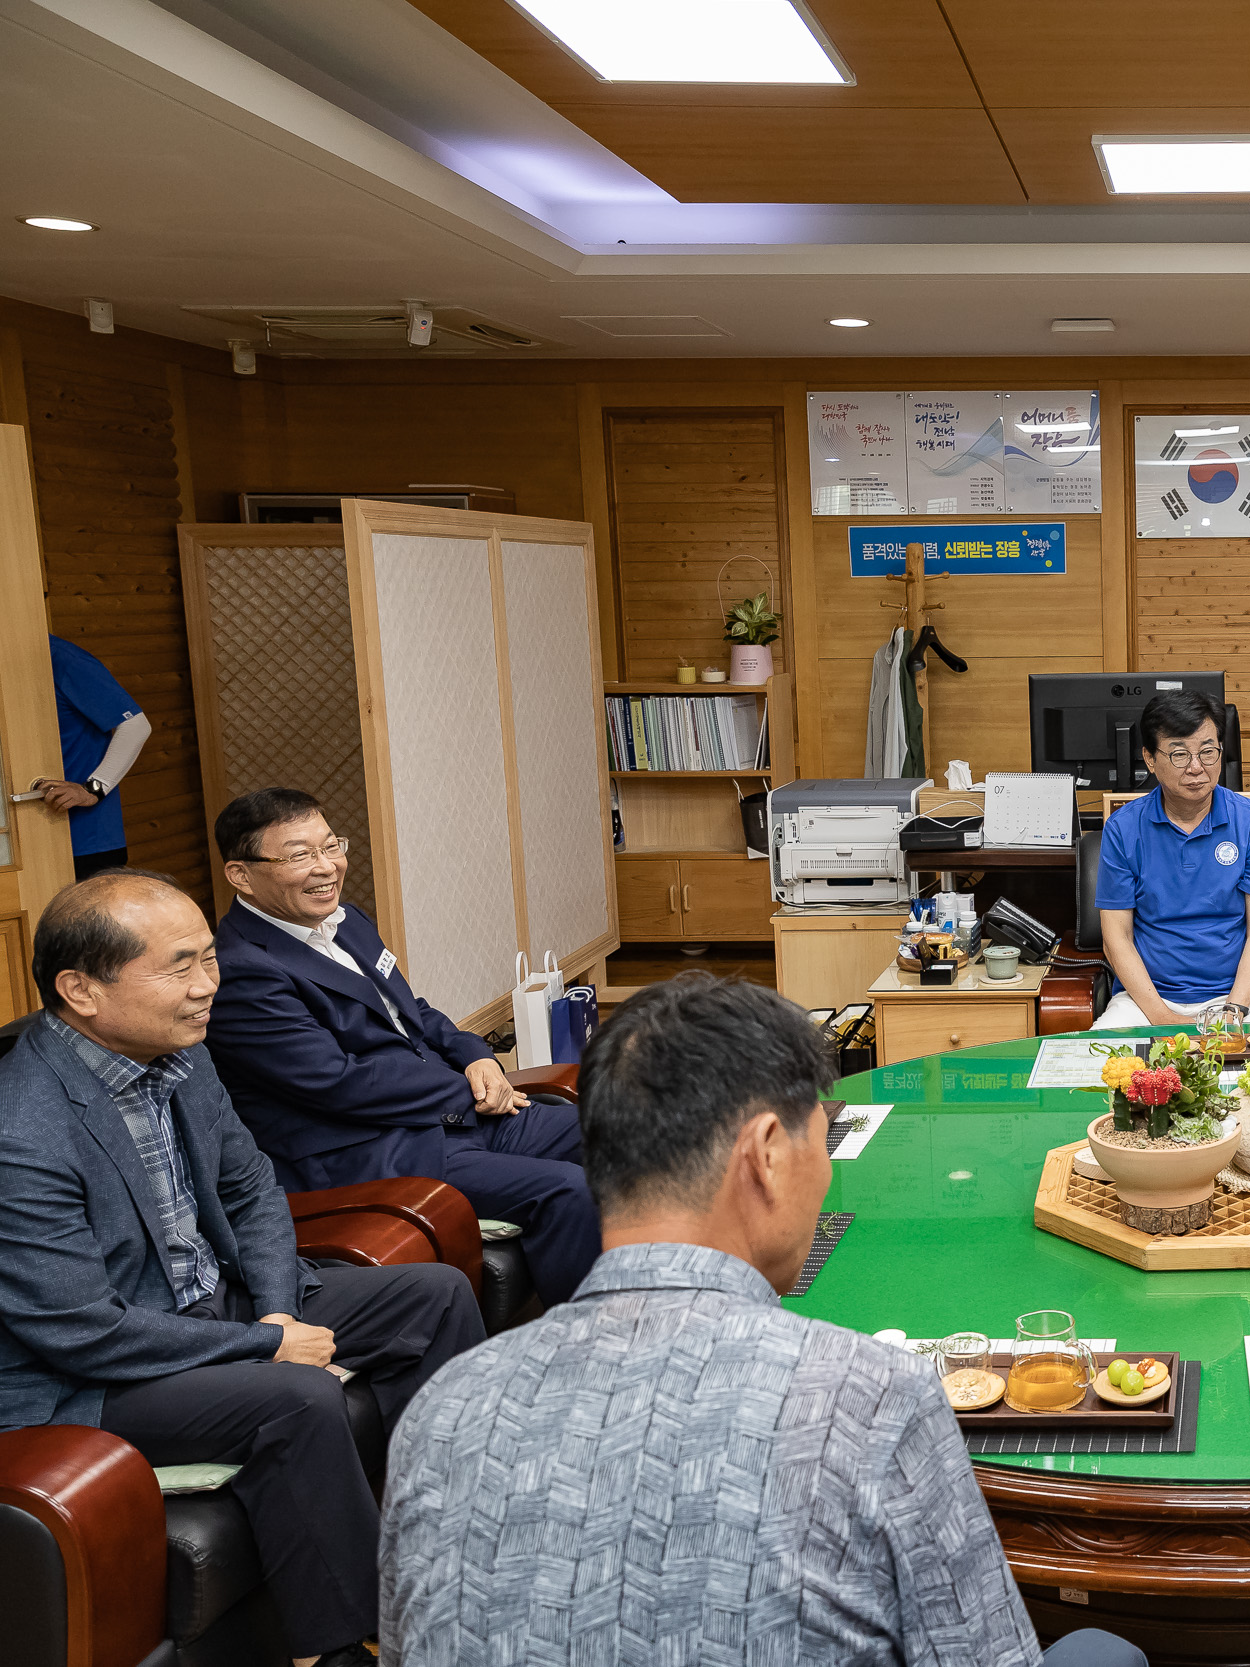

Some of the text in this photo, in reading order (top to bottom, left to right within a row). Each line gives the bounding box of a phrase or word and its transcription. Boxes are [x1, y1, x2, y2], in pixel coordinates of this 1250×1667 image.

[945, 541, 993, 559] 신뢰받는
[995, 541, 1021, 559] 장흥
[1126, 686, 1142, 696] LG
[994, 785, 1005, 795] 07
